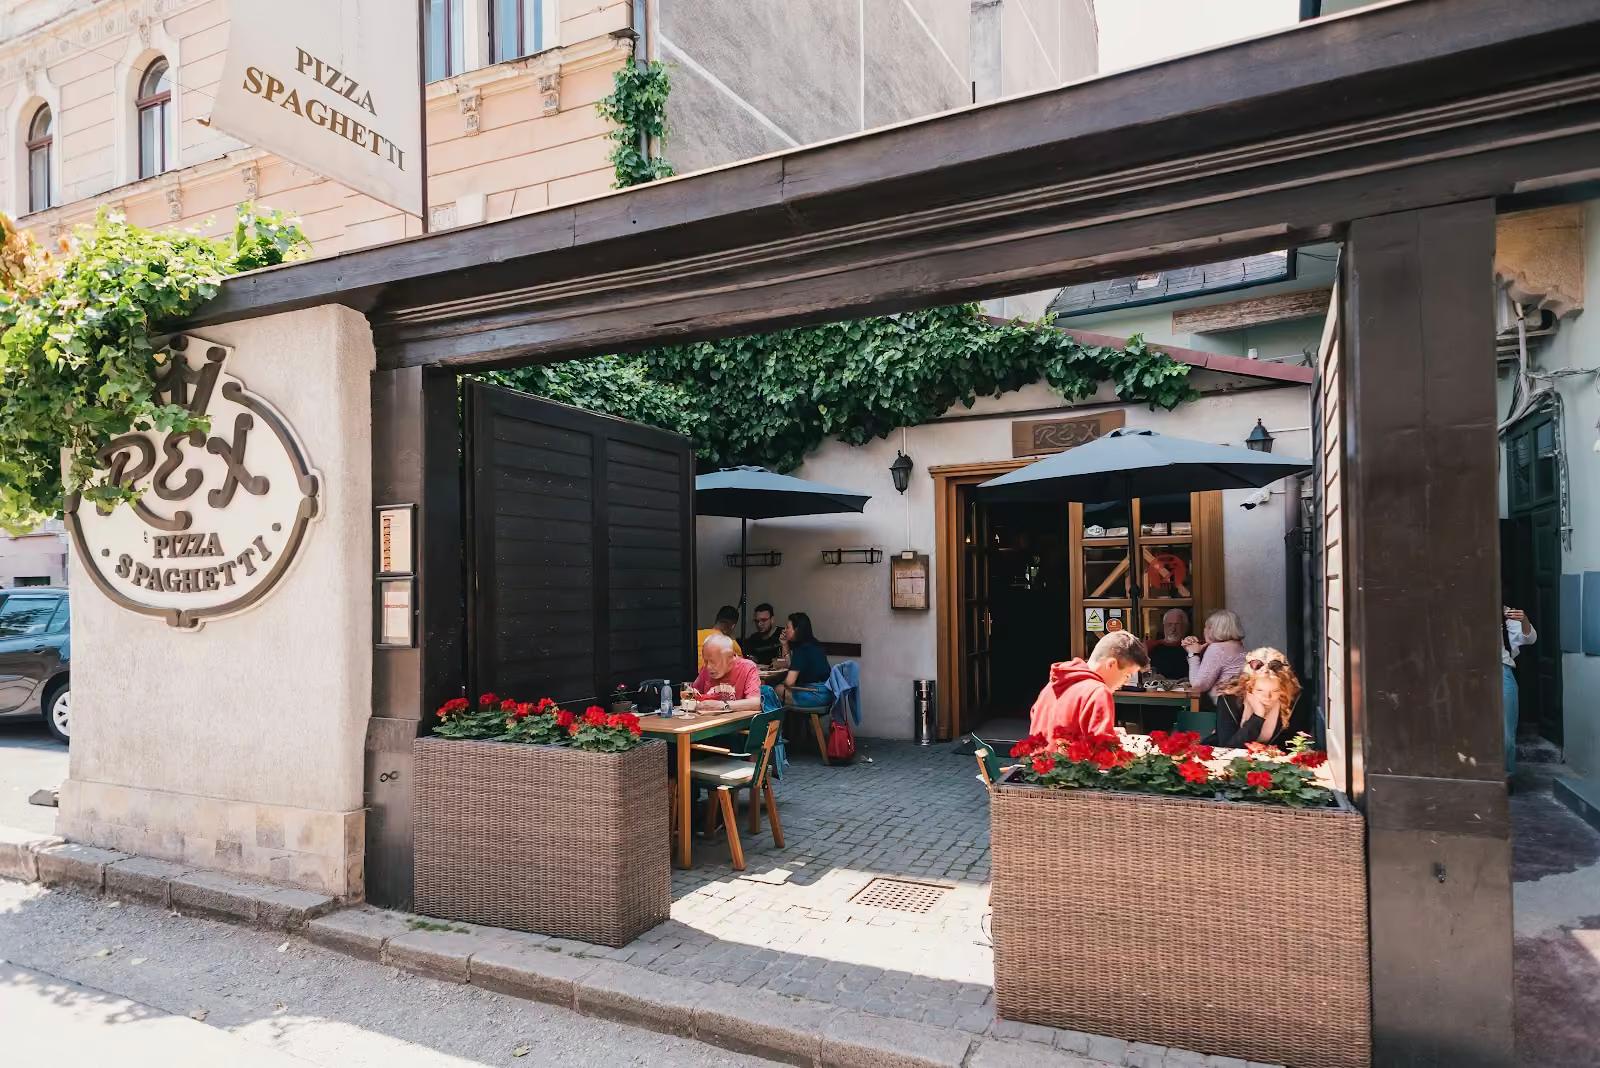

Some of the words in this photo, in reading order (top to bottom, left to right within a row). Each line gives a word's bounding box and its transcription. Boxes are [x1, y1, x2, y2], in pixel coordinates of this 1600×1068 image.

[295, 46, 377, 117] PIZZA
[242, 66, 406, 172] SPAGHETTI
[1035, 422, 1097, 447] REX
[97, 413, 270, 531] REX
[115, 535, 273, 593] SPAGHETTI
[152, 532, 225, 559] PIZZA
